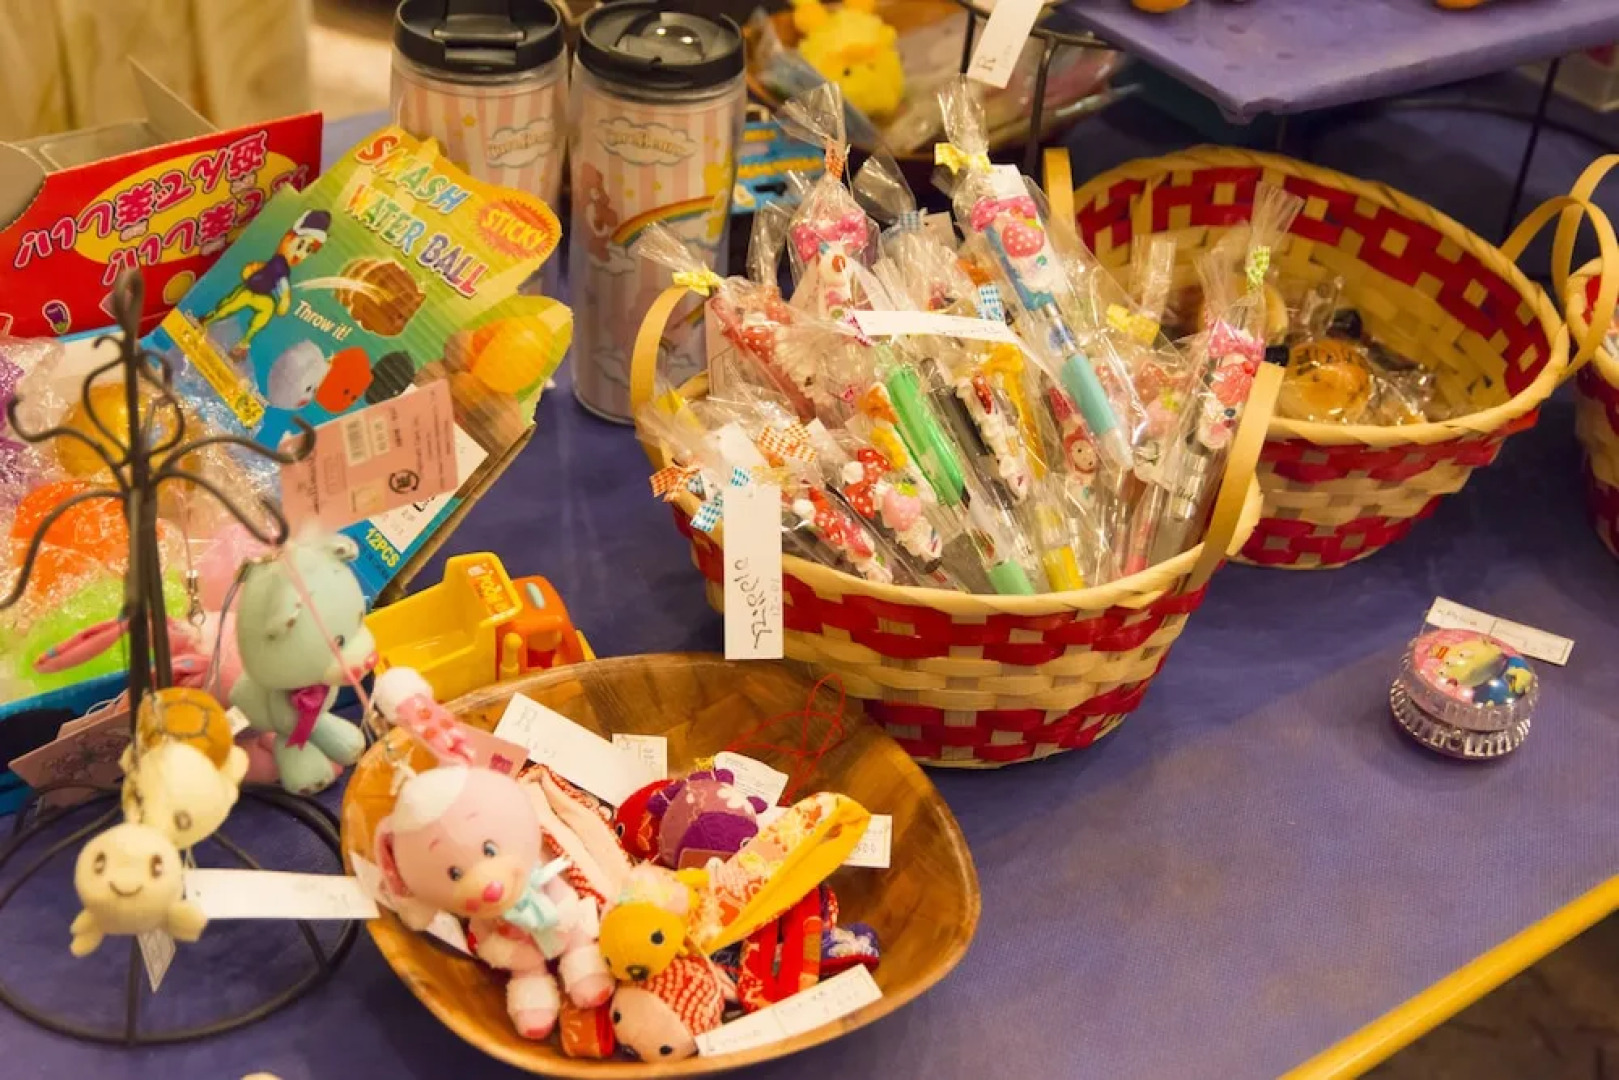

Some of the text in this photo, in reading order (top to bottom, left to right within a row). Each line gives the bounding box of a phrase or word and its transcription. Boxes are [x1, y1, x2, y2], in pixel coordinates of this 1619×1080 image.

[13, 130, 268, 268] 遊んで楽しい!
[355, 135, 471, 215] SMASH
[345, 183, 489, 298] WATER BALL
[481, 209, 549, 250] STICKY
[294, 300, 353, 341] Throw it!
[365, 528, 401, 568] 12PCS
